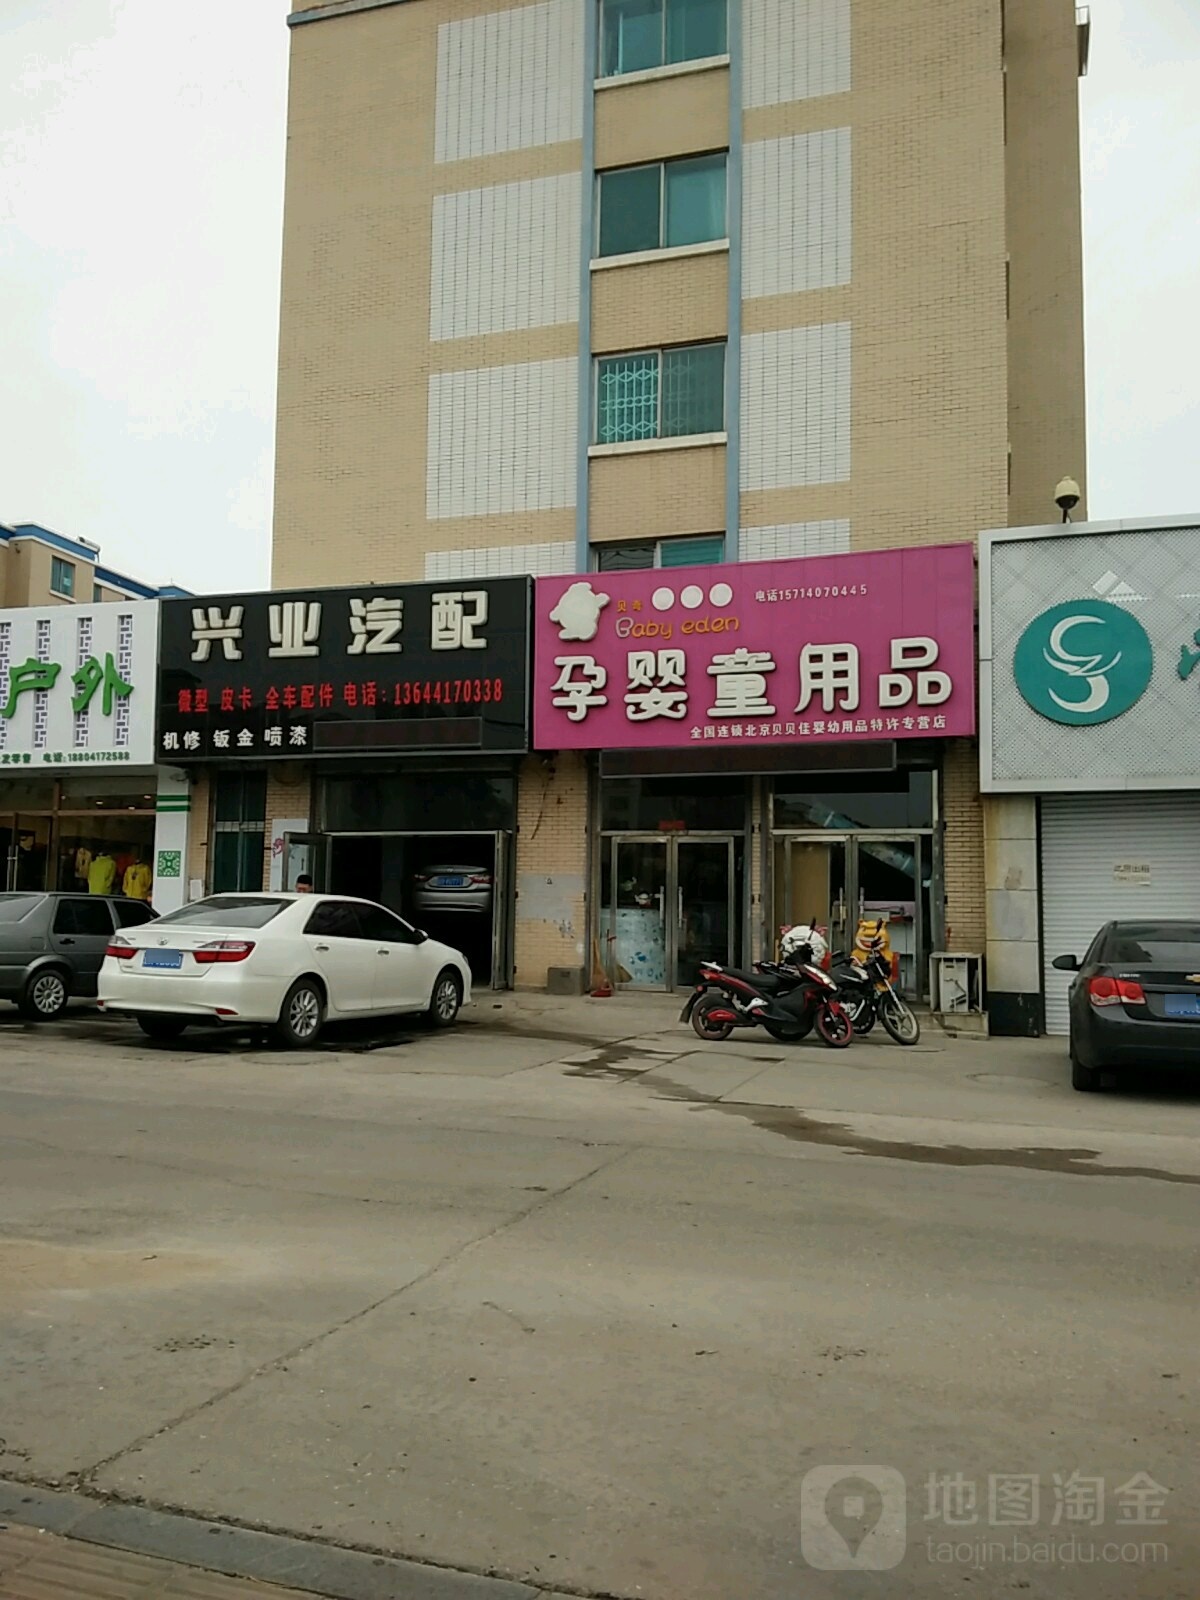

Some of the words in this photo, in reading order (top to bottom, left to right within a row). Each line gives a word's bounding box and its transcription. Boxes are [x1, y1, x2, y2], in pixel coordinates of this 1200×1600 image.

[190, 590, 488, 662] 兴业汽配
[615, 616, 673, 639] Baby
[680, 616, 740, 634] eden
[550, 636, 953, 722] 孕婴童用品
[220, 686, 252, 711] 皮卡
[265, 682, 333, 709] 全车配件
[162, 731, 201, 750] 机修
[212, 728, 254, 748] 钣金
[264, 725, 307, 747] 喷漆
